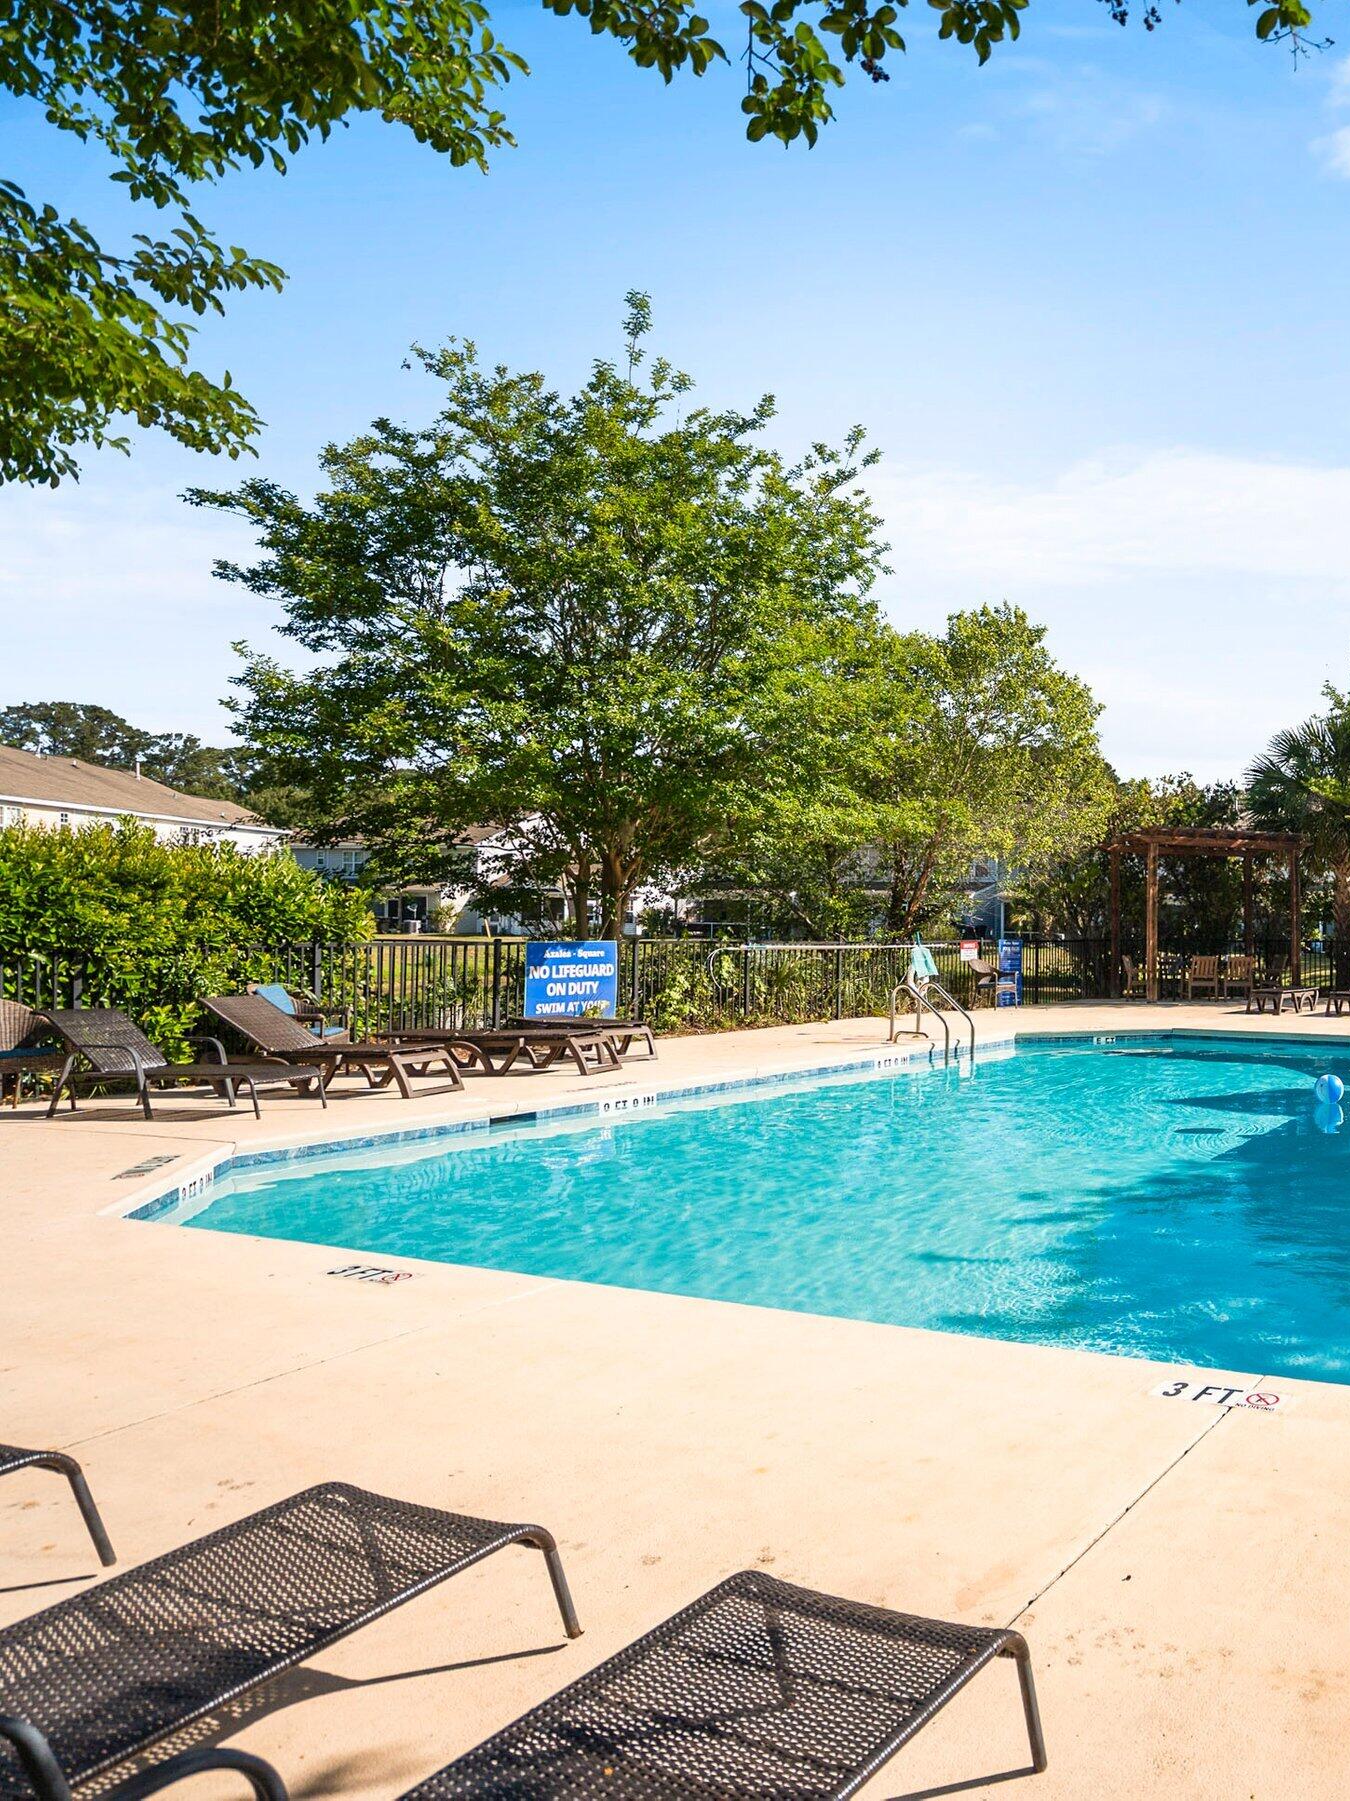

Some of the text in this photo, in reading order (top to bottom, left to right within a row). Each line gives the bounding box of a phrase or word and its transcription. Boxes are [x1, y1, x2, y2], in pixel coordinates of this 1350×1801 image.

[544, 949, 571, 958] Azalea
[577, 949, 604, 958] Square
[529, 963, 614, 979] NO LIFEGUARD
[546, 981, 599, 996] ON DUTY
[535, 1002, 566, 1014] SWIM
[567, 1001, 580, 1012] AT
[1162, 1382, 1244, 1404] 3 FT
